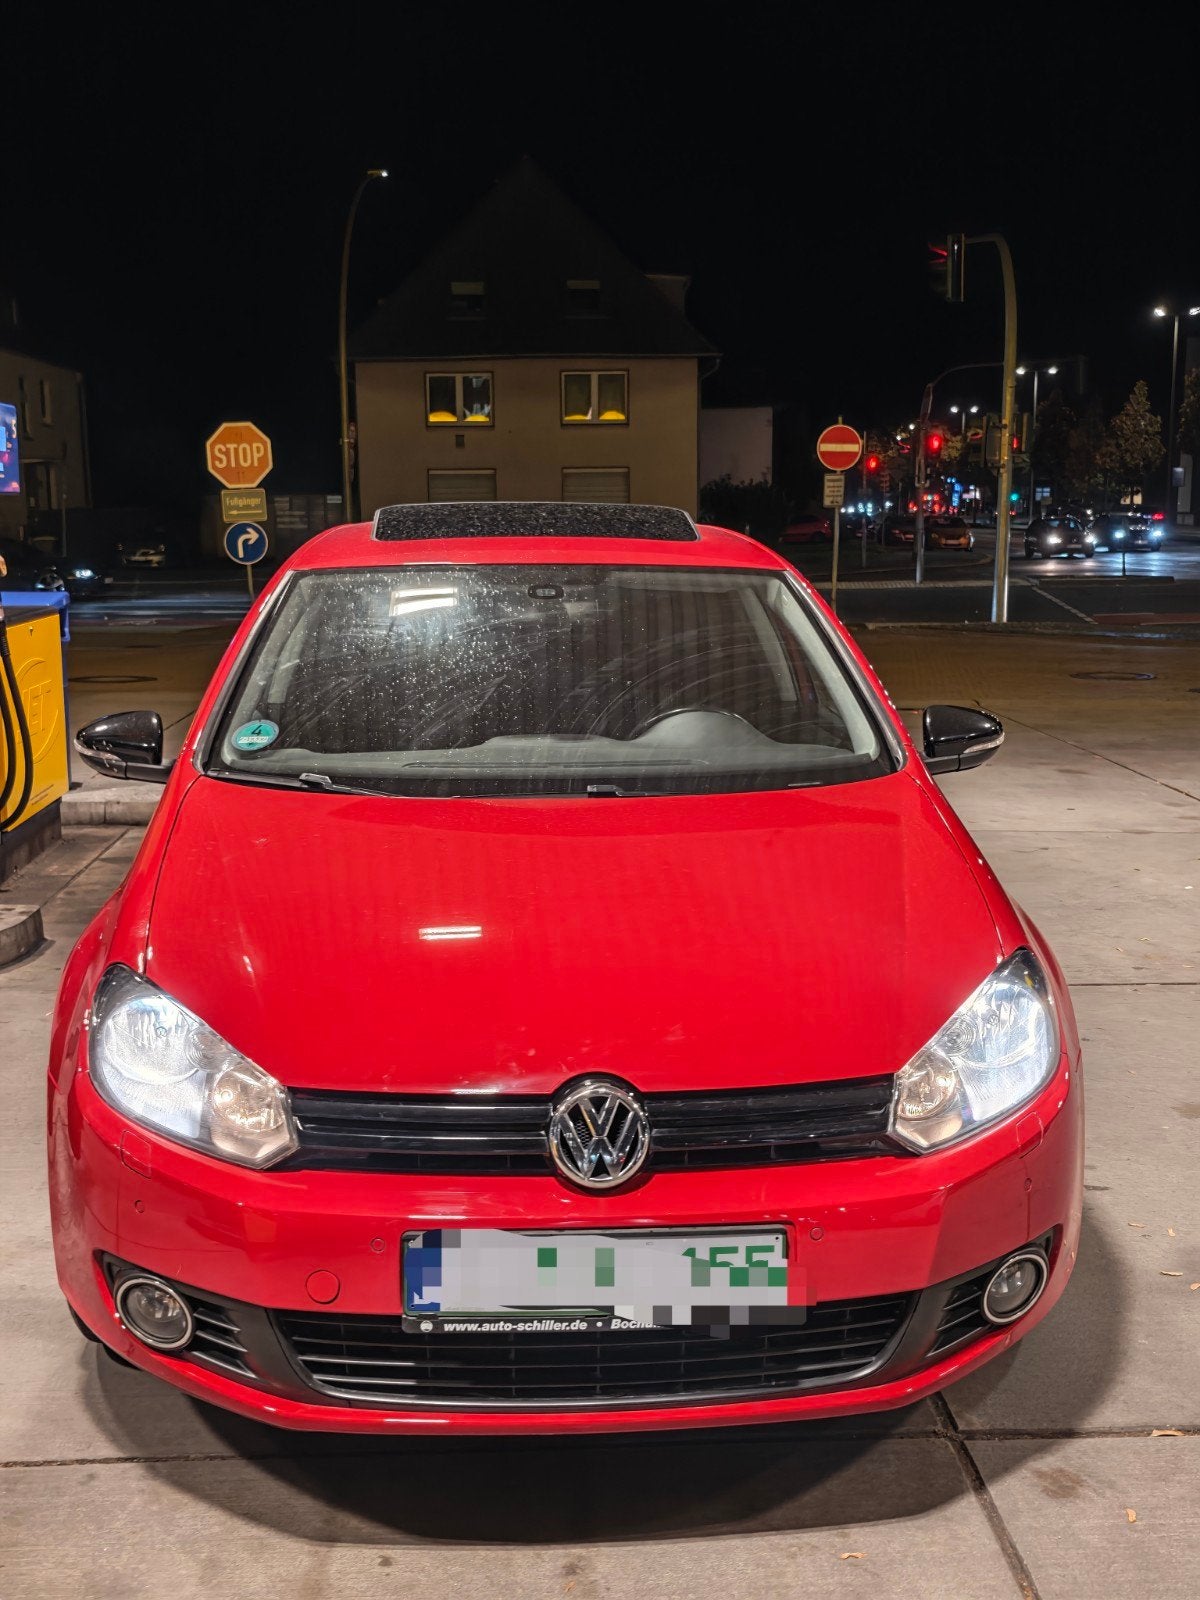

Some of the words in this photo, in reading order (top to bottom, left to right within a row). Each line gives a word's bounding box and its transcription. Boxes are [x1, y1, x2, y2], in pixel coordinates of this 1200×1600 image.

[214, 442, 265, 469] STOP
[251, 724, 263, 736] 4
[556, 1090, 644, 1182] VW
[443, 1319, 588, 1332] www.auto-schiller.de
